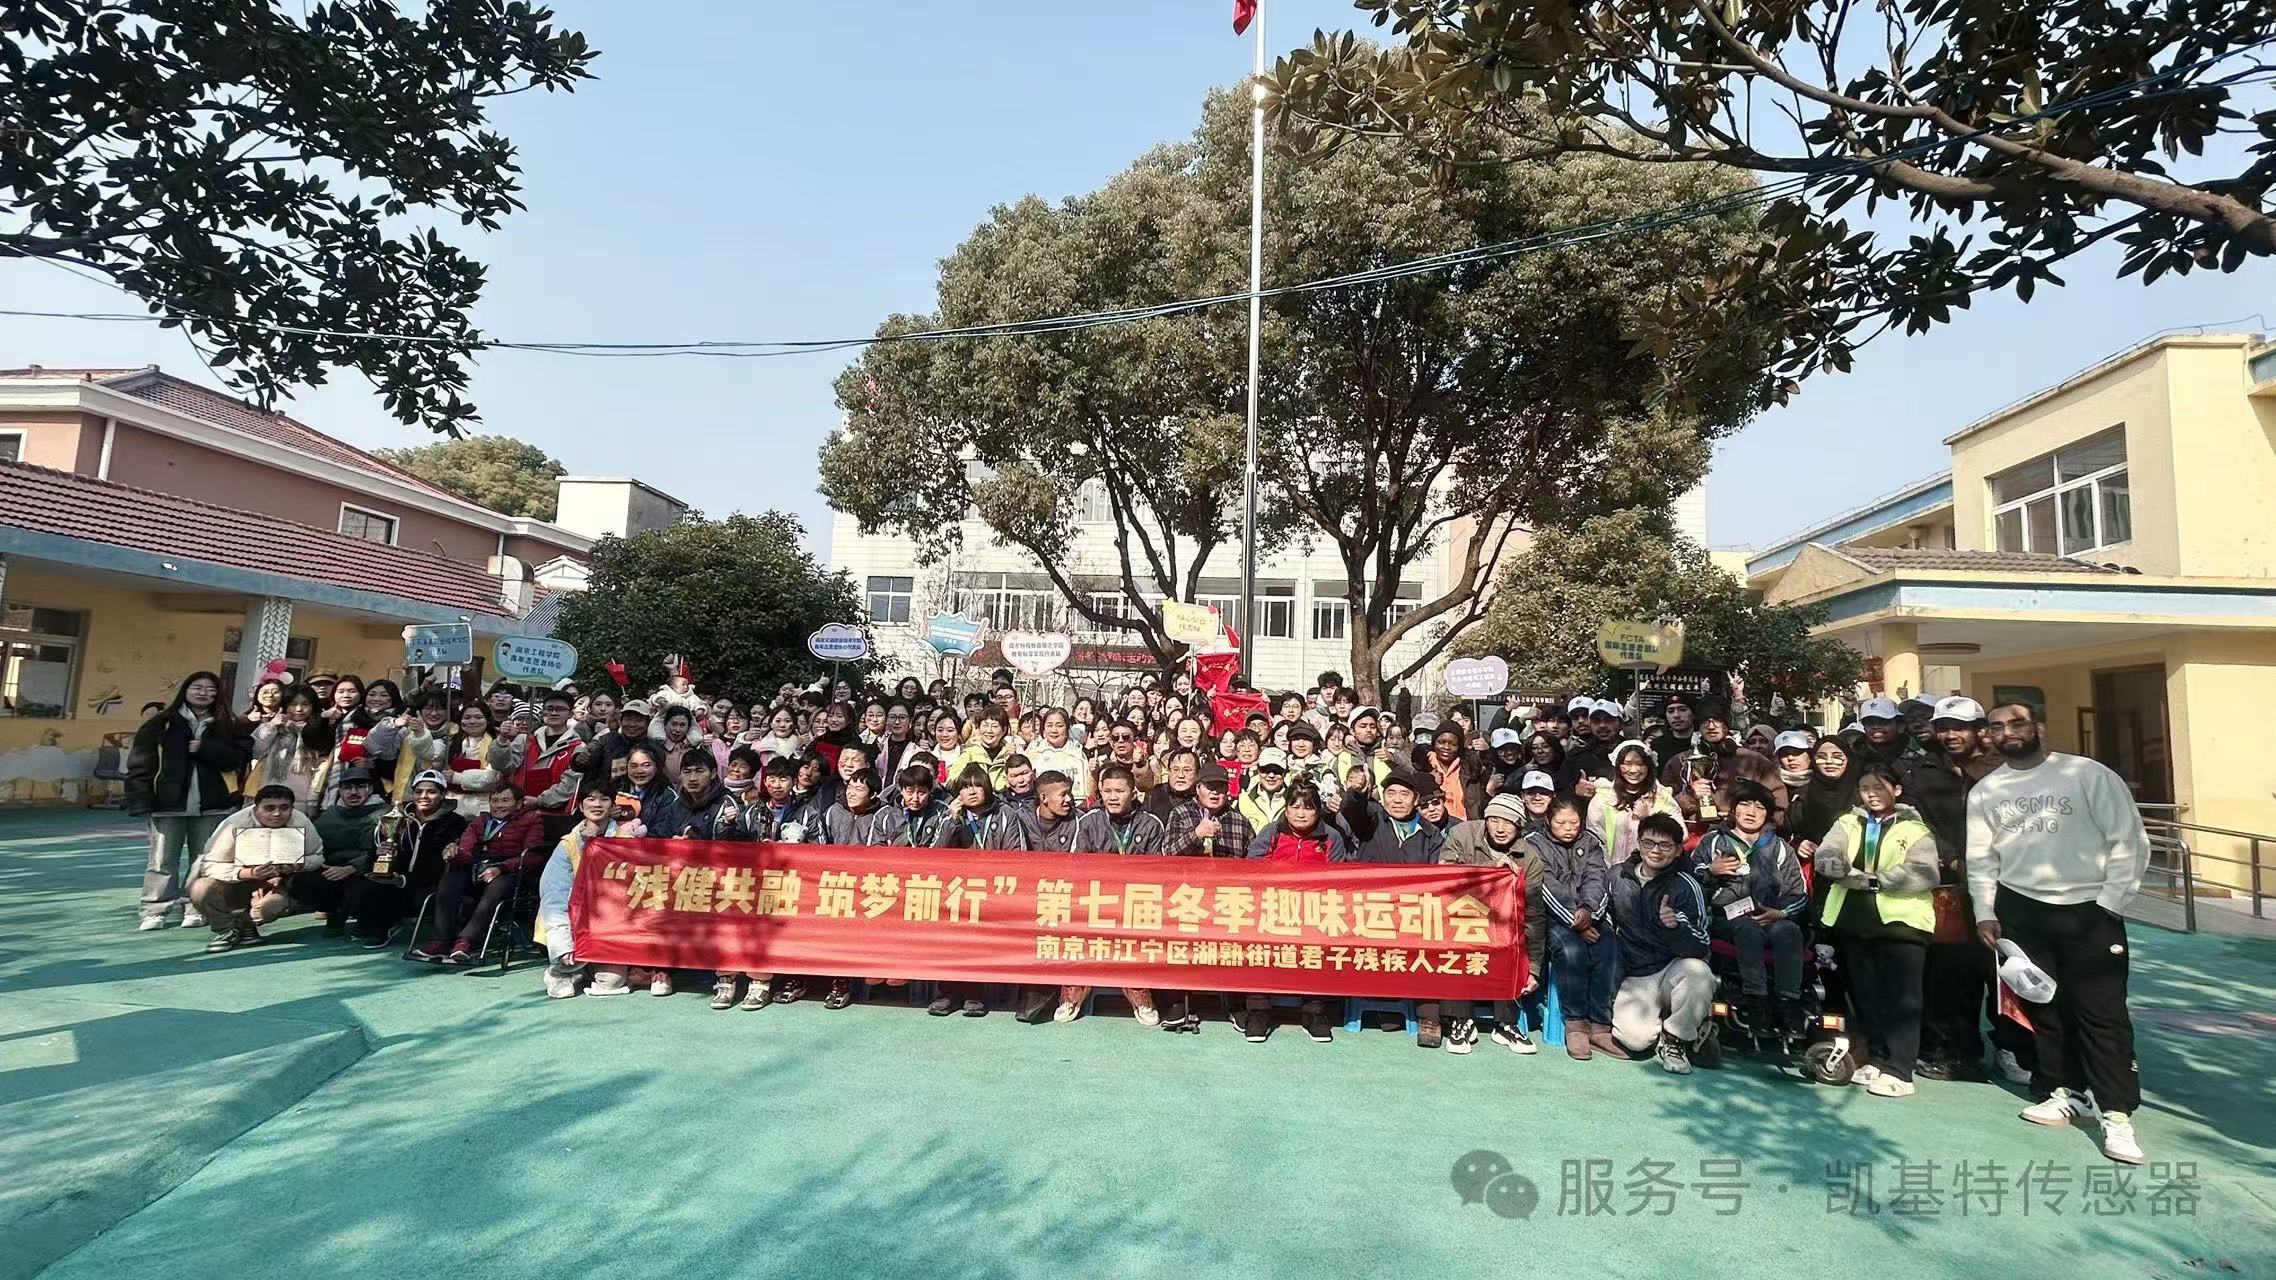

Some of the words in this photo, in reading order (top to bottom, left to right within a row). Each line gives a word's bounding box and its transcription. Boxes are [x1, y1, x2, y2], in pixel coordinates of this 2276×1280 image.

[1620, 634, 1645, 643] FCTA
[515, 646, 560, 659] 南京工程学院
[510, 655, 562, 669] 青年志愿者协会
[522, 666, 544, 675] 代表队
[1035, 877, 1492, 944] 第七届冬季趣味运动会
[1035, 935, 1491, 976] 南京市江宁区湖熟街道君子残疾人之家
